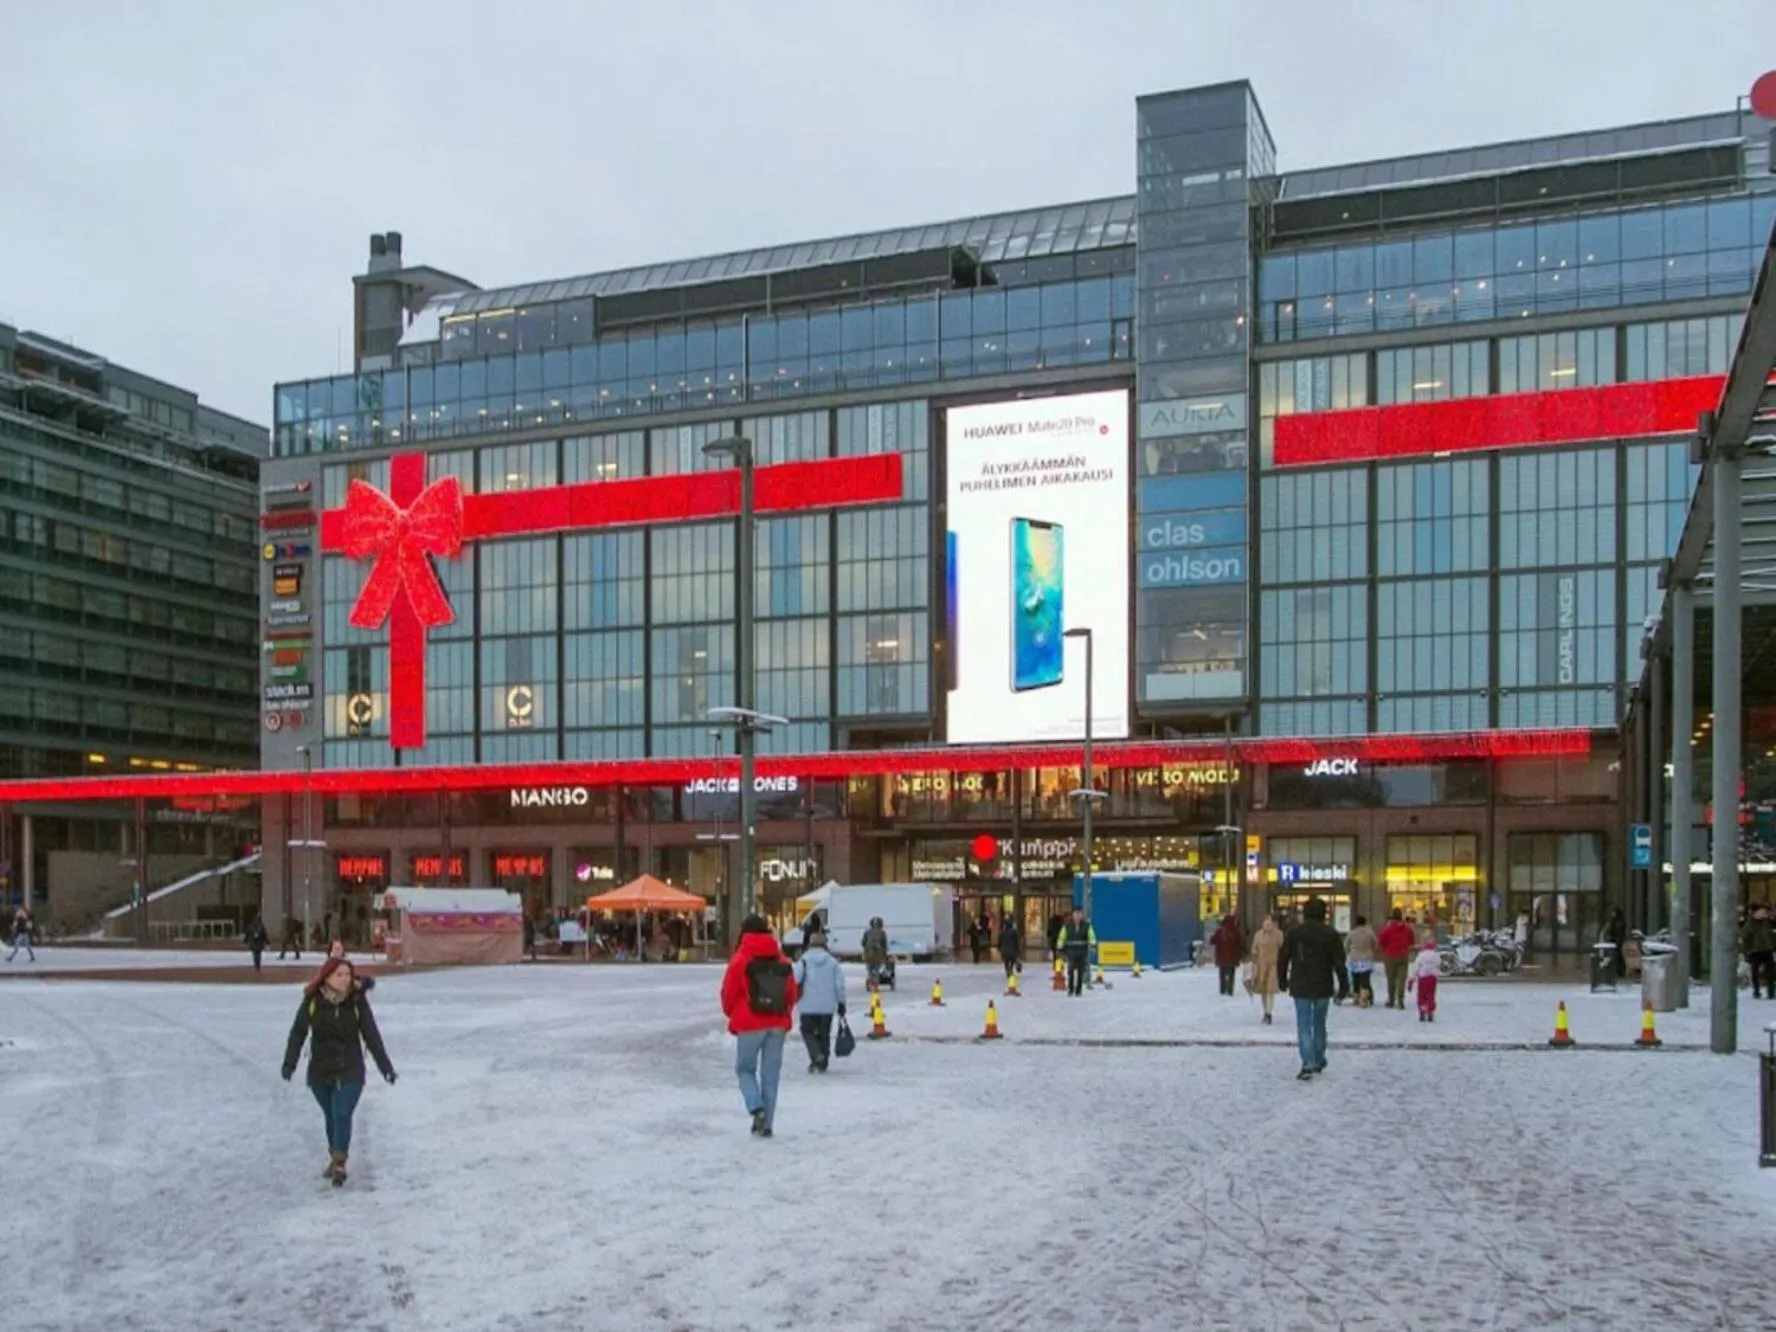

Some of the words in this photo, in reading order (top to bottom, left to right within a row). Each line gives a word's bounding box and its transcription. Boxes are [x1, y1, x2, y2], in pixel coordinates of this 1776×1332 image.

[964, 423, 1022, 439] HUAWEI
[981, 454, 1086, 476] ÄLYKKÄÄMMÄN
[960, 474, 1036, 492] PUHELIMEN
[1040, 469, 1113, 486] AIKAKAUSI
[1147, 521, 1204, 547] clas
[1148, 555, 1239, 583] ohlson
[1559, 577, 1572, 682] CARLINGS
[1303, 758, 1358, 776] JACK
[685, 778, 726, 794] JACK
[753, 776, 798, 793] ONES
[511, 787, 589, 808] MANGO
